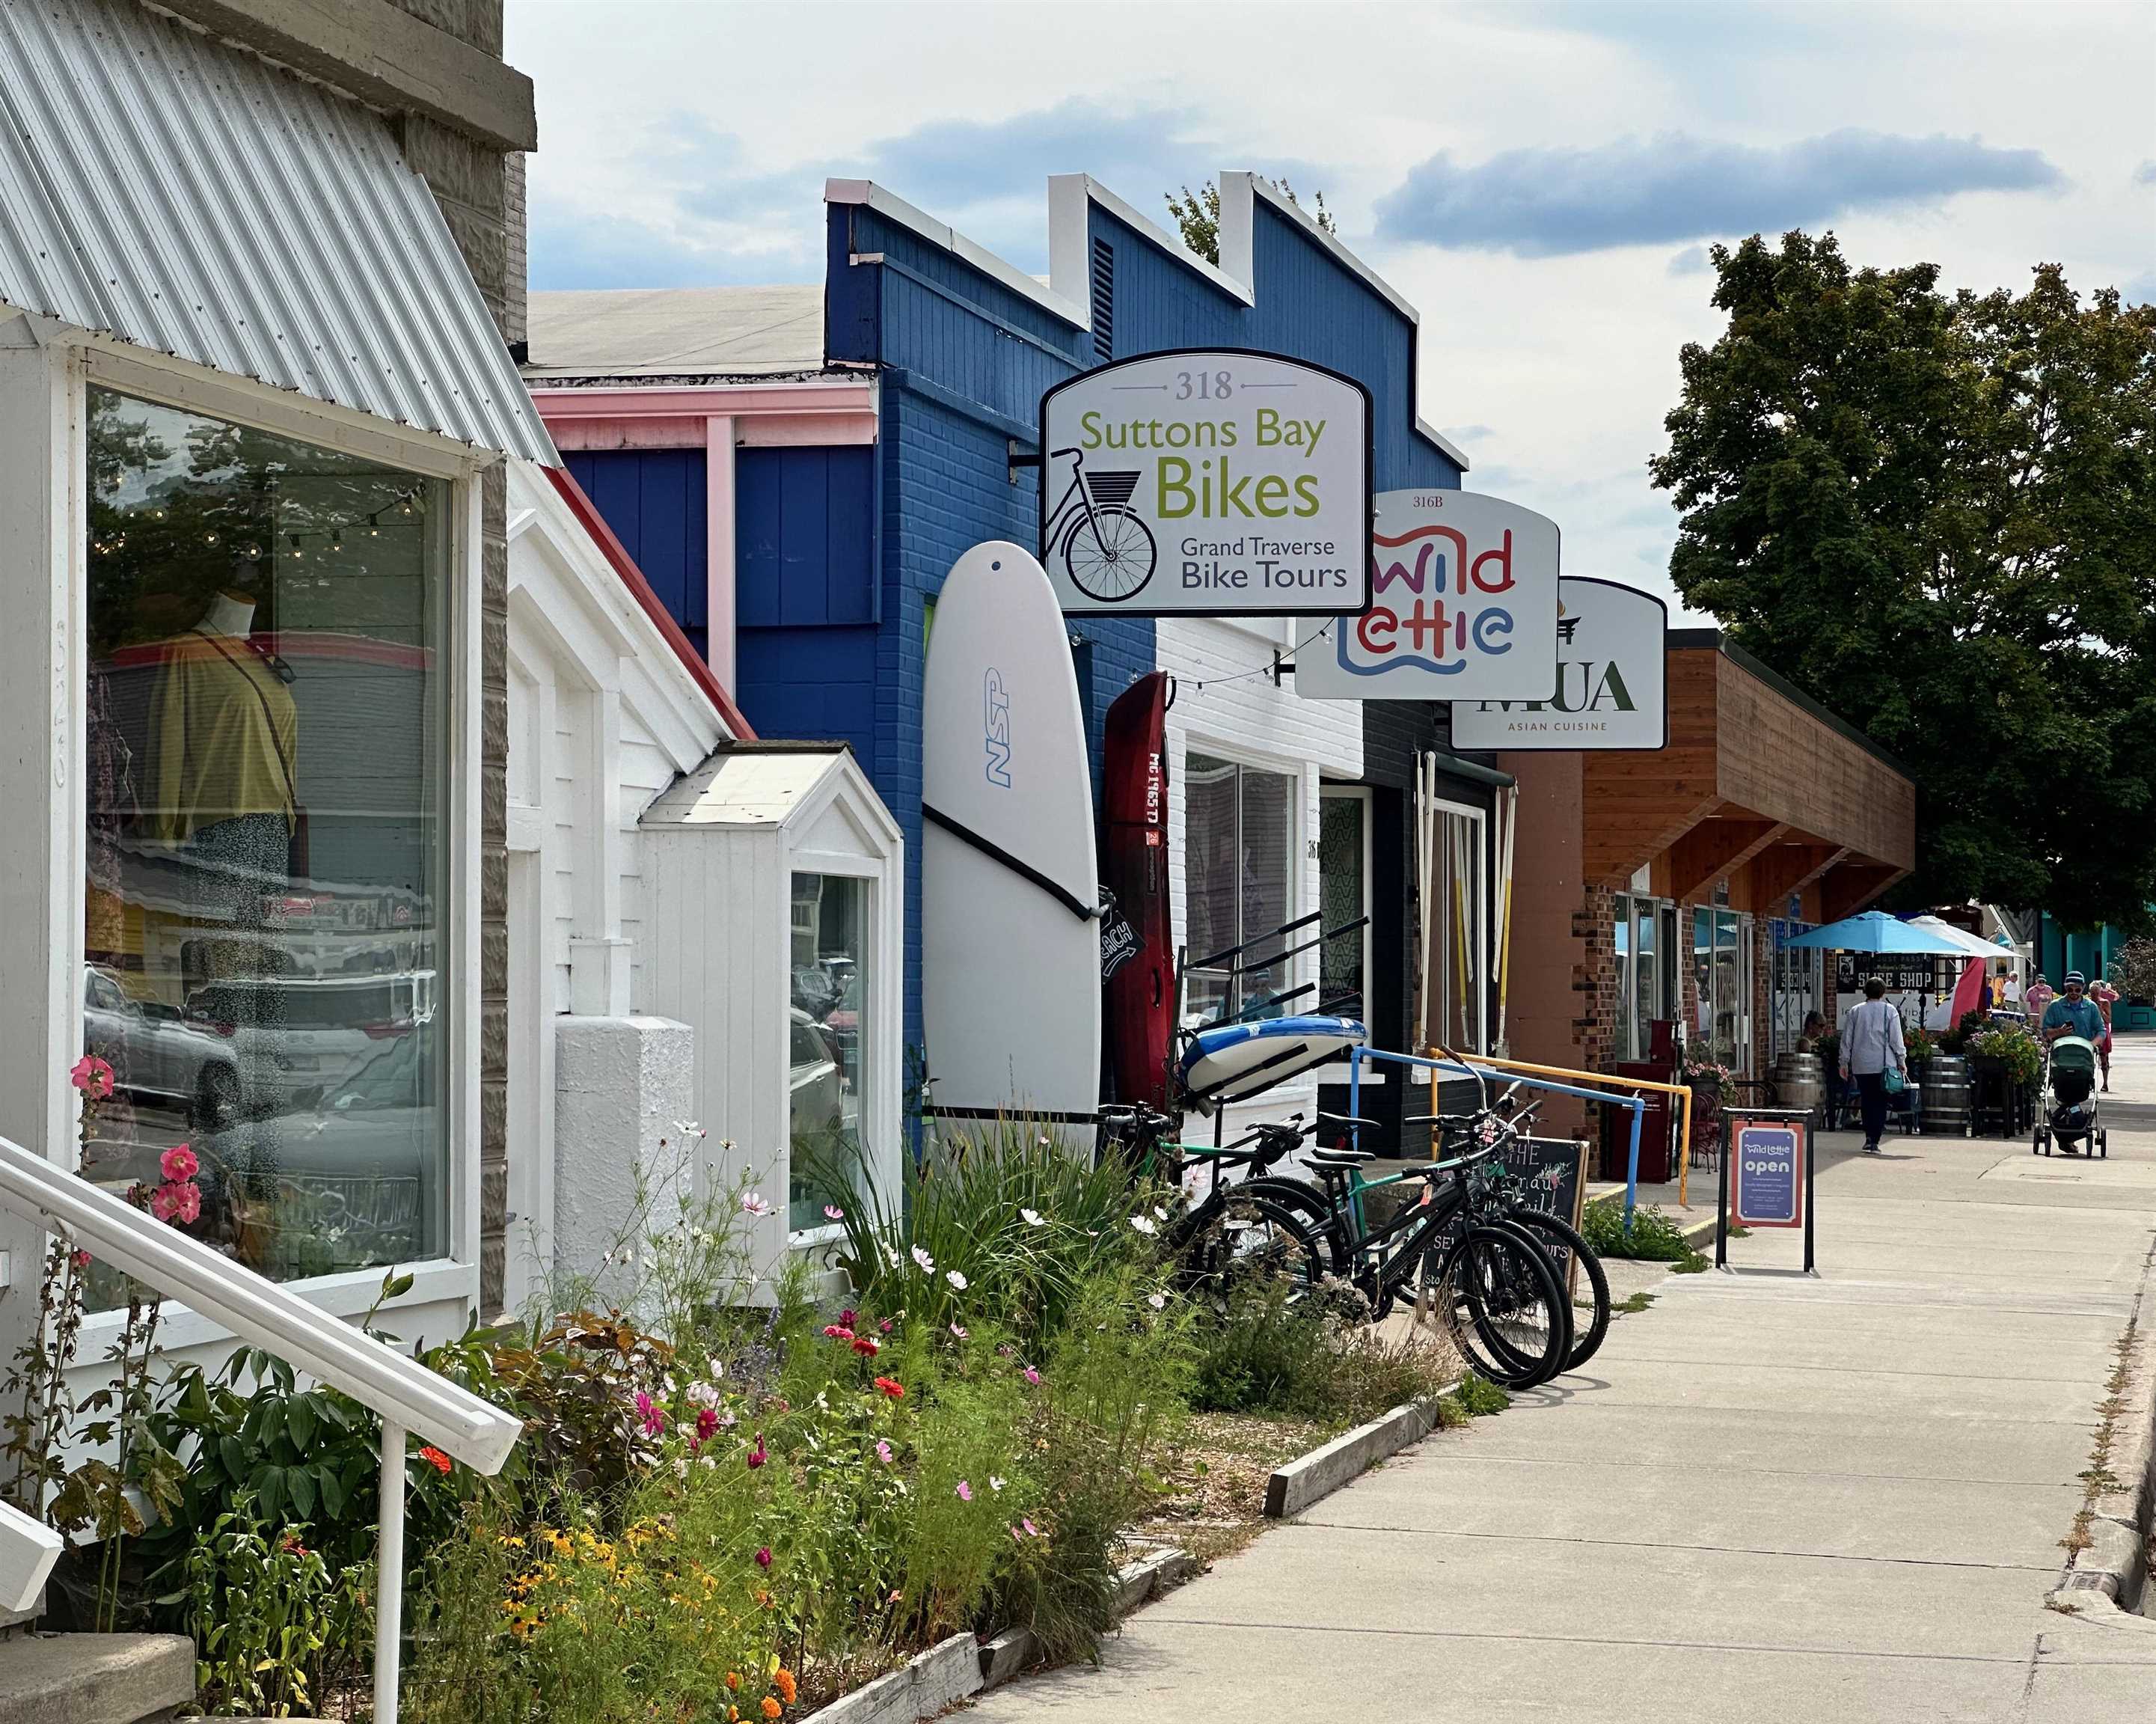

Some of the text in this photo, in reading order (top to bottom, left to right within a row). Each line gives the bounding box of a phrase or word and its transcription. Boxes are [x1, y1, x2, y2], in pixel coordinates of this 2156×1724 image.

[1176, 371, 1232, 400] 318
[1081, 409, 1326, 457] Suttons Bay
[1158, 456, 1320, 519] Bikes
[1413, 496, 1442, 507] 316B
[1181, 537, 1334, 556] Grand Traverse
[1182, 561, 1347, 588] Bike Tours
[1476, 661, 1638, 712] UA
[984, 667, 1011, 789] NSP
[1508, 722, 1607, 731] ASIAN CUISINE
[1149, 753, 1160, 774] MC
[1148, 777, 1159, 807] 1965
[1150, 832, 1158, 844] 26
[1100, 921, 1133, 968] EACH
[1900, 972, 1931, 987] SHOP
[1905, 1007, 1929, 1016] fibr
[1745, 1161, 1789, 1176] open
